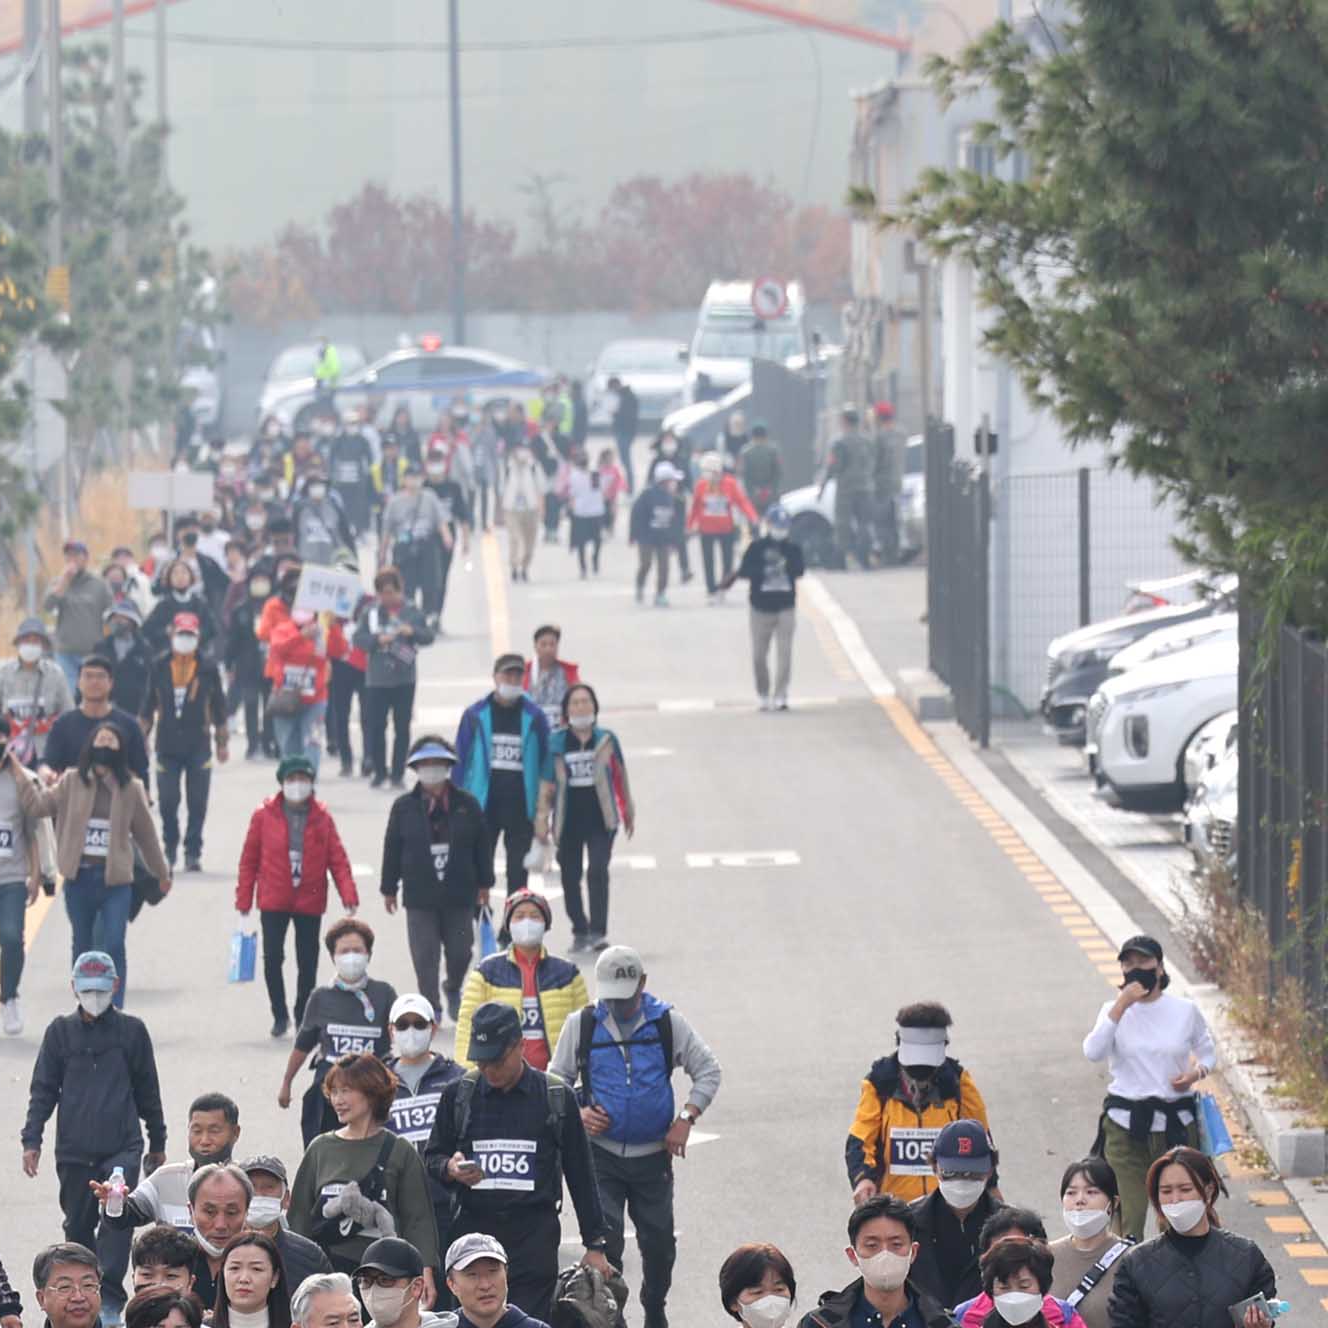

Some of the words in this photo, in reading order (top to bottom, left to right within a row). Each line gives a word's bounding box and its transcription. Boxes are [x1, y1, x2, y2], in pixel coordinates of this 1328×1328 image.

[332, 1036, 376, 1055] 1254
[392, 1105, 437, 1130] 1132
[895, 1140, 935, 1161] 105
[479, 1154, 530, 1174] 1056
